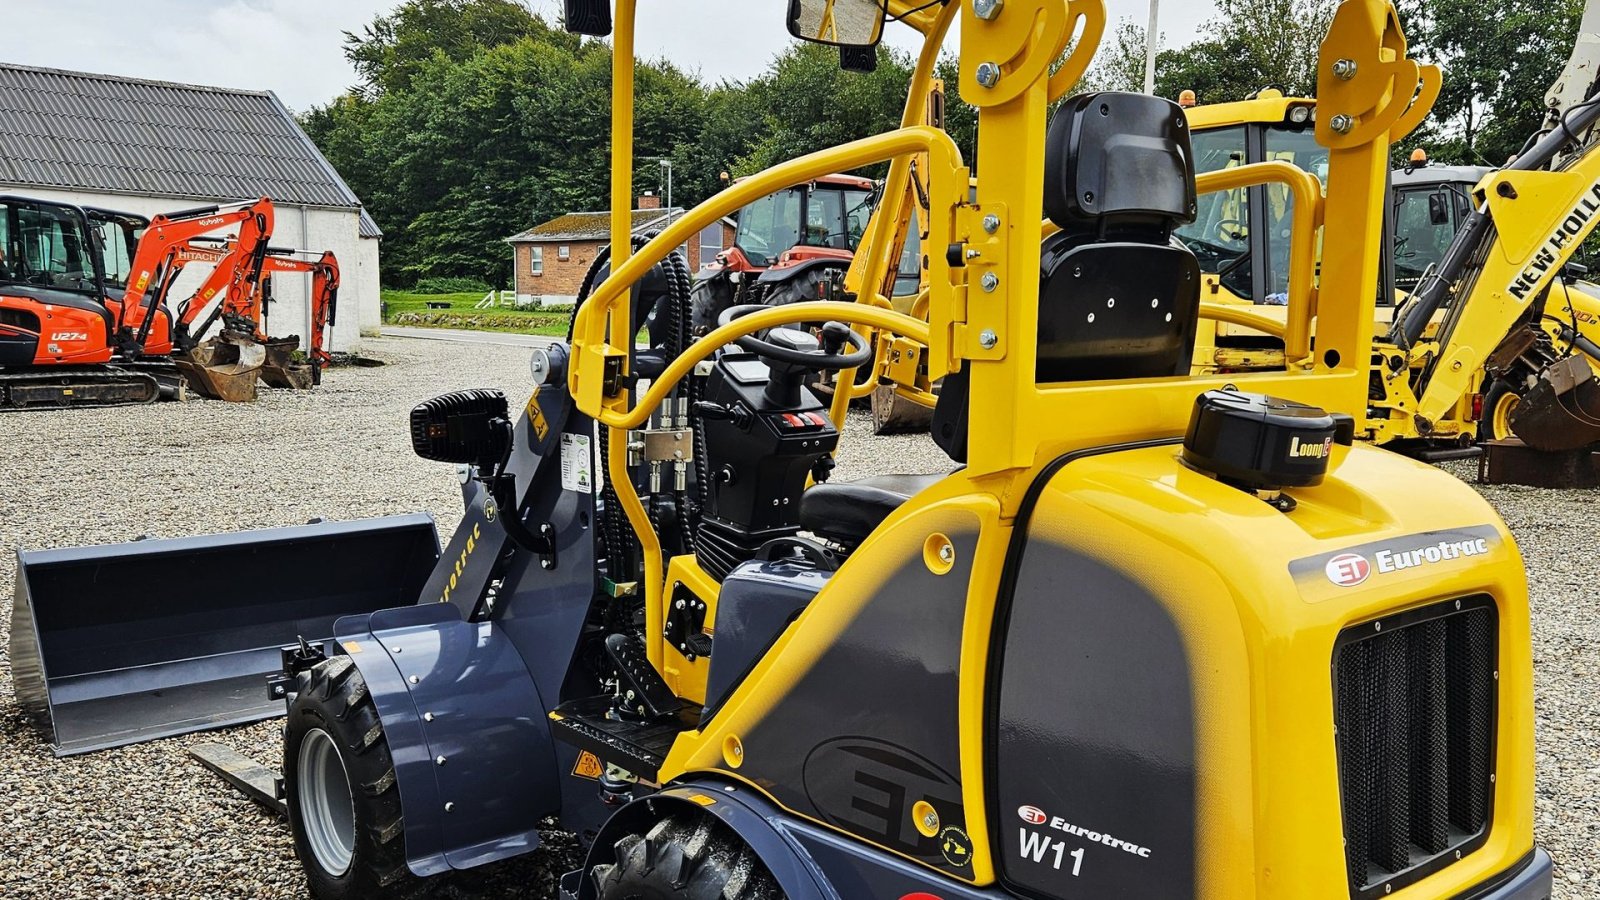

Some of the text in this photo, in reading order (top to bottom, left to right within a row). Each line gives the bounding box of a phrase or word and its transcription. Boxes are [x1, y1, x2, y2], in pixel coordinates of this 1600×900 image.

[198, 217, 224, 226] Kubota
[275, 259, 297, 268] Kubota
[1508, 247, 1555, 300] NEW
[51, 332, 87, 340] U27-4
[440, 521, 480, 603] rotrac
[1329, 537, 1489, 584] ET Eurotrac
[1020, 827, 1085, 877] W11
[1021, 807, 1151, 858] ET Eurotrac
